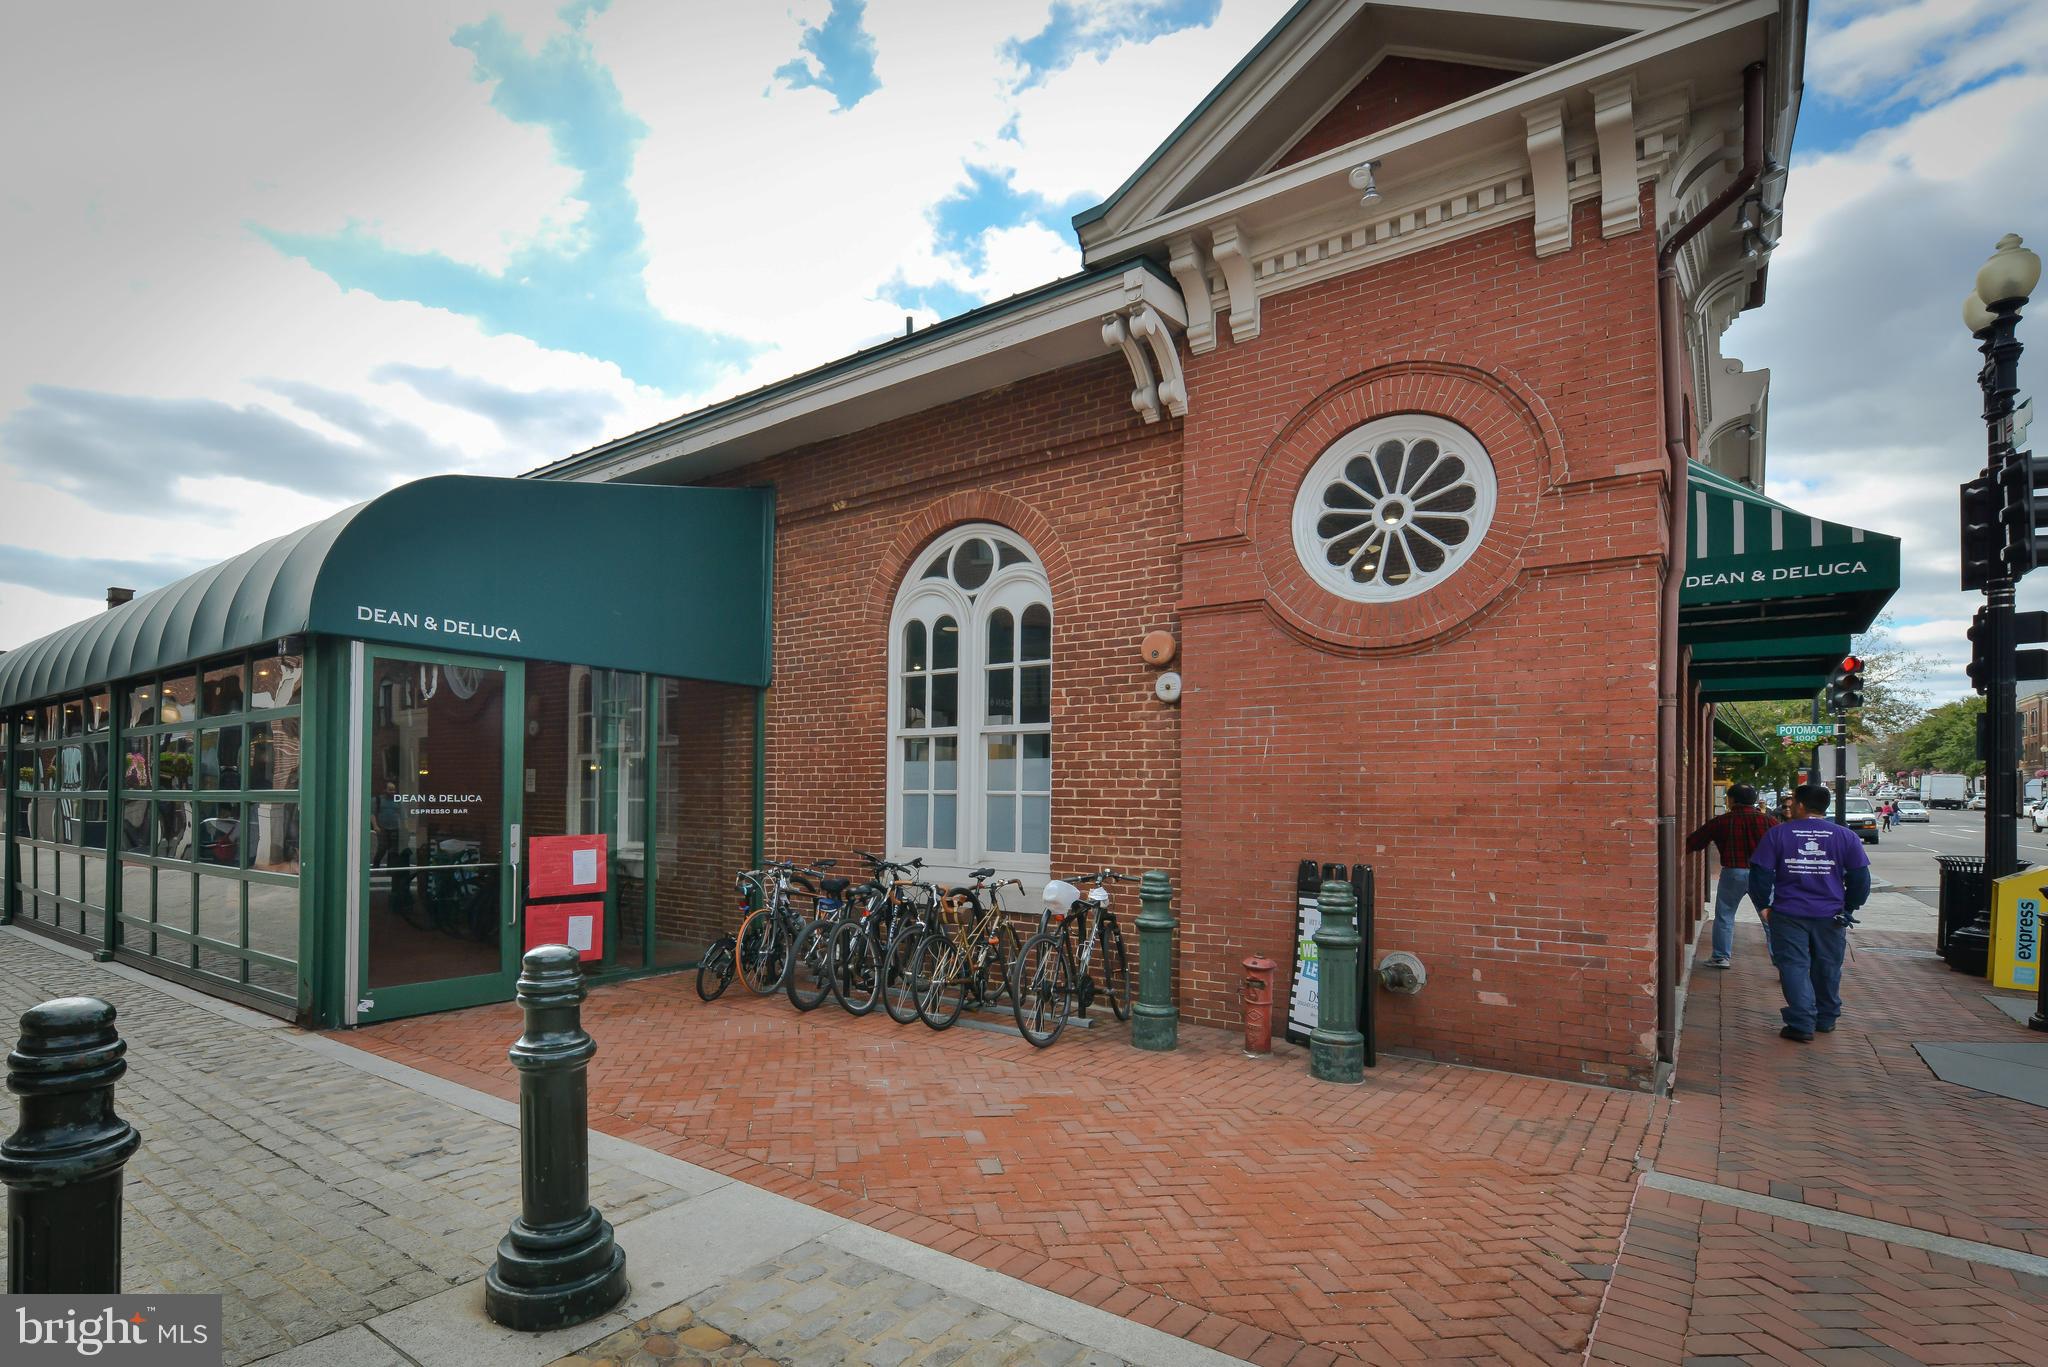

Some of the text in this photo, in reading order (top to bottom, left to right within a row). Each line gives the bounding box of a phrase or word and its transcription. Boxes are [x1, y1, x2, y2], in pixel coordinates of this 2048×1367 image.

[1685, 561, 1867, 588] DEAN & DELUCA
[357, 605, 521, 642] DEAN & DELUCA
[1779, 726, 1823, 735] POTOMAC
[393, 794, 483, 803] DEAN & DELUCA
[2018, 901, 2035, 960] express
